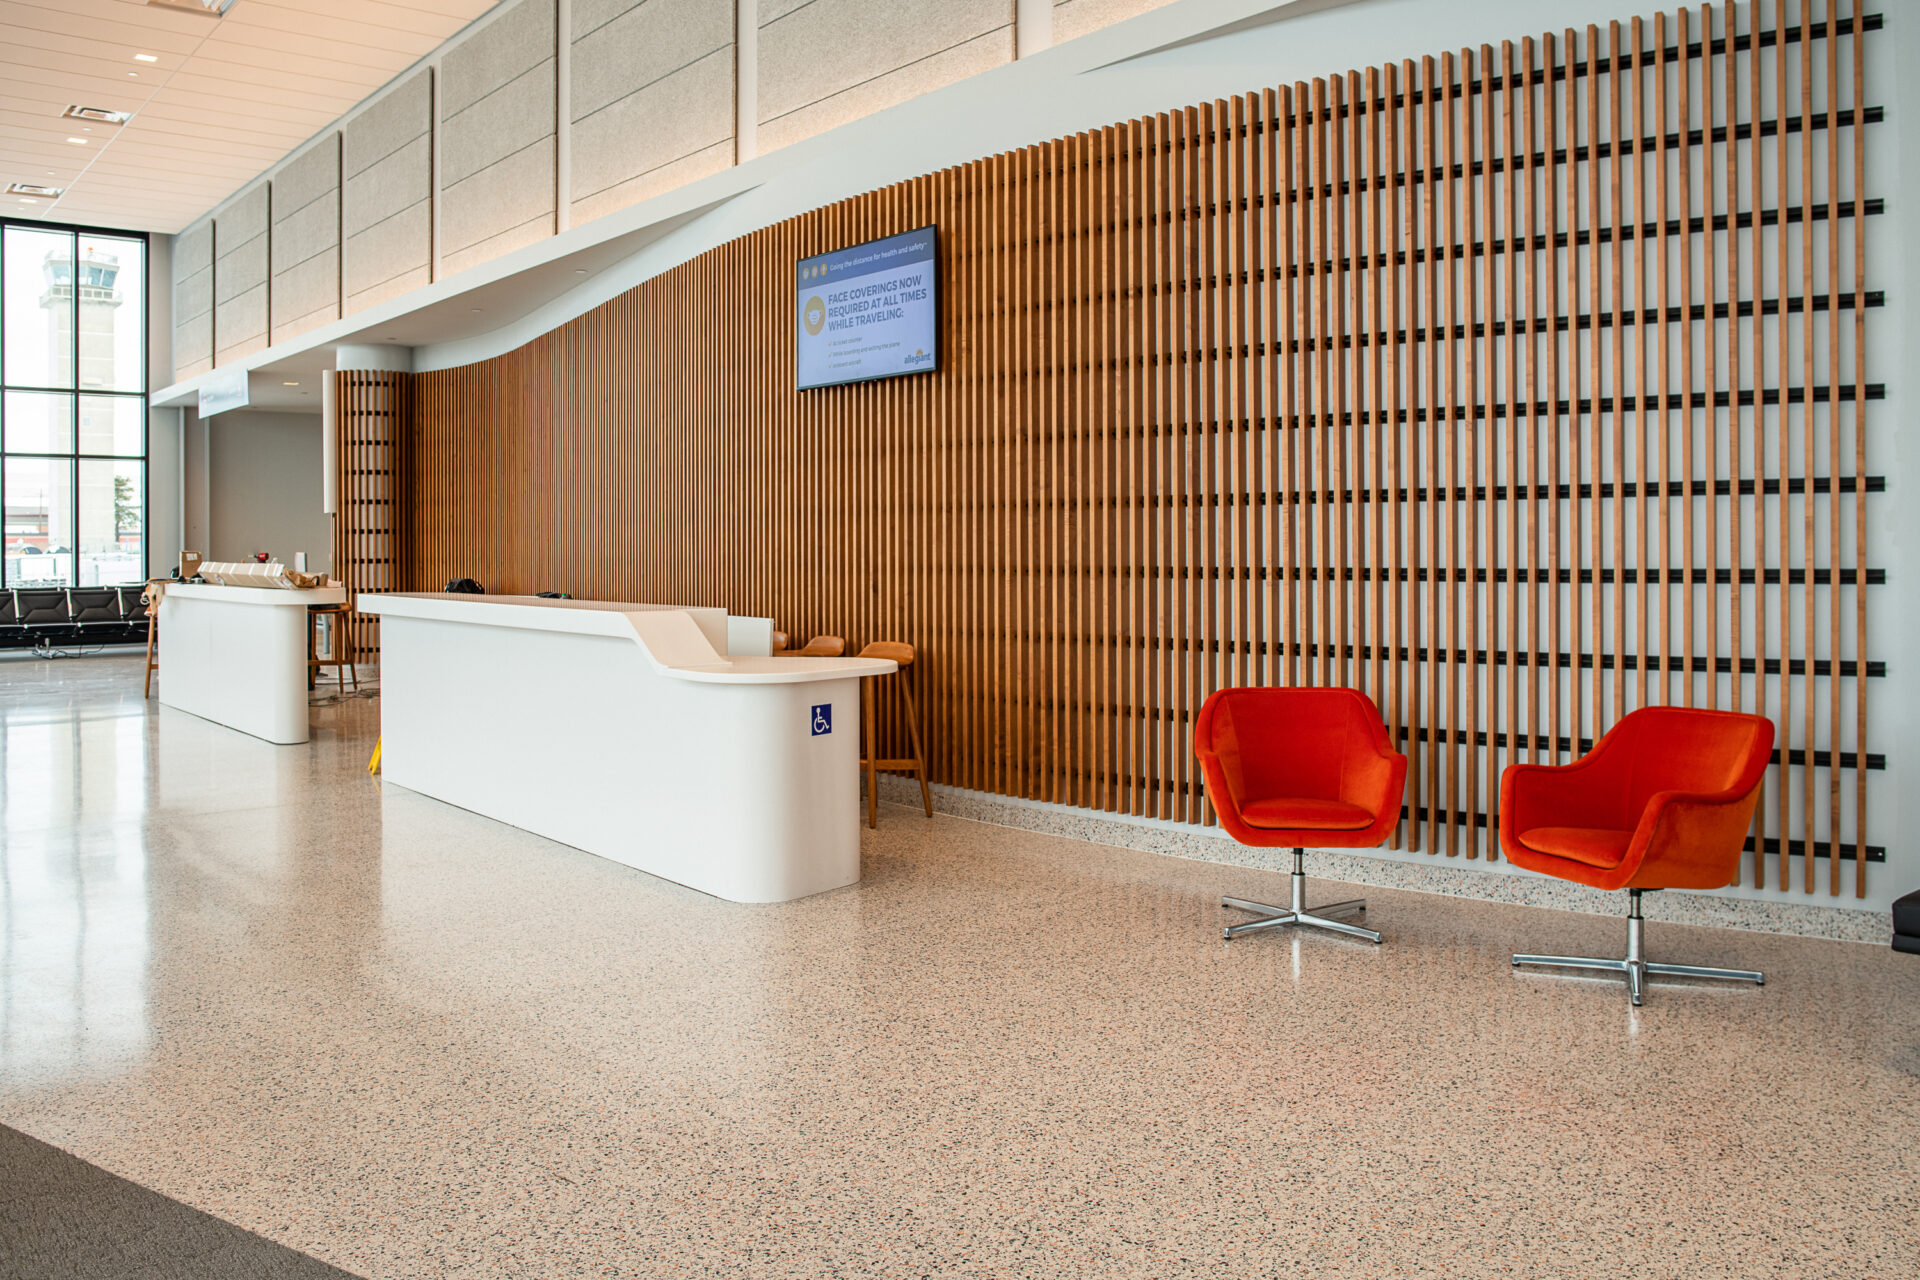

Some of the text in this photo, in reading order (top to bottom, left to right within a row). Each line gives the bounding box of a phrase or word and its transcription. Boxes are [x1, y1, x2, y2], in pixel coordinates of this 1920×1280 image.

[829, 263, 844, 272] Going
[844, 260, 852, 268] the
[852, 255, 873, 266] distance
[881, 248, 898, 258] health
[898, 245, 908, 254] and
[828, 274, 922, 305] FACE COVERINGS NOW
[828, 288, 927, 318] REQUIRED AT ALL TIMES
[828, 308, 904, 331] WHILE TRAVELING:
[904, 353, 931, 365] allegiant
